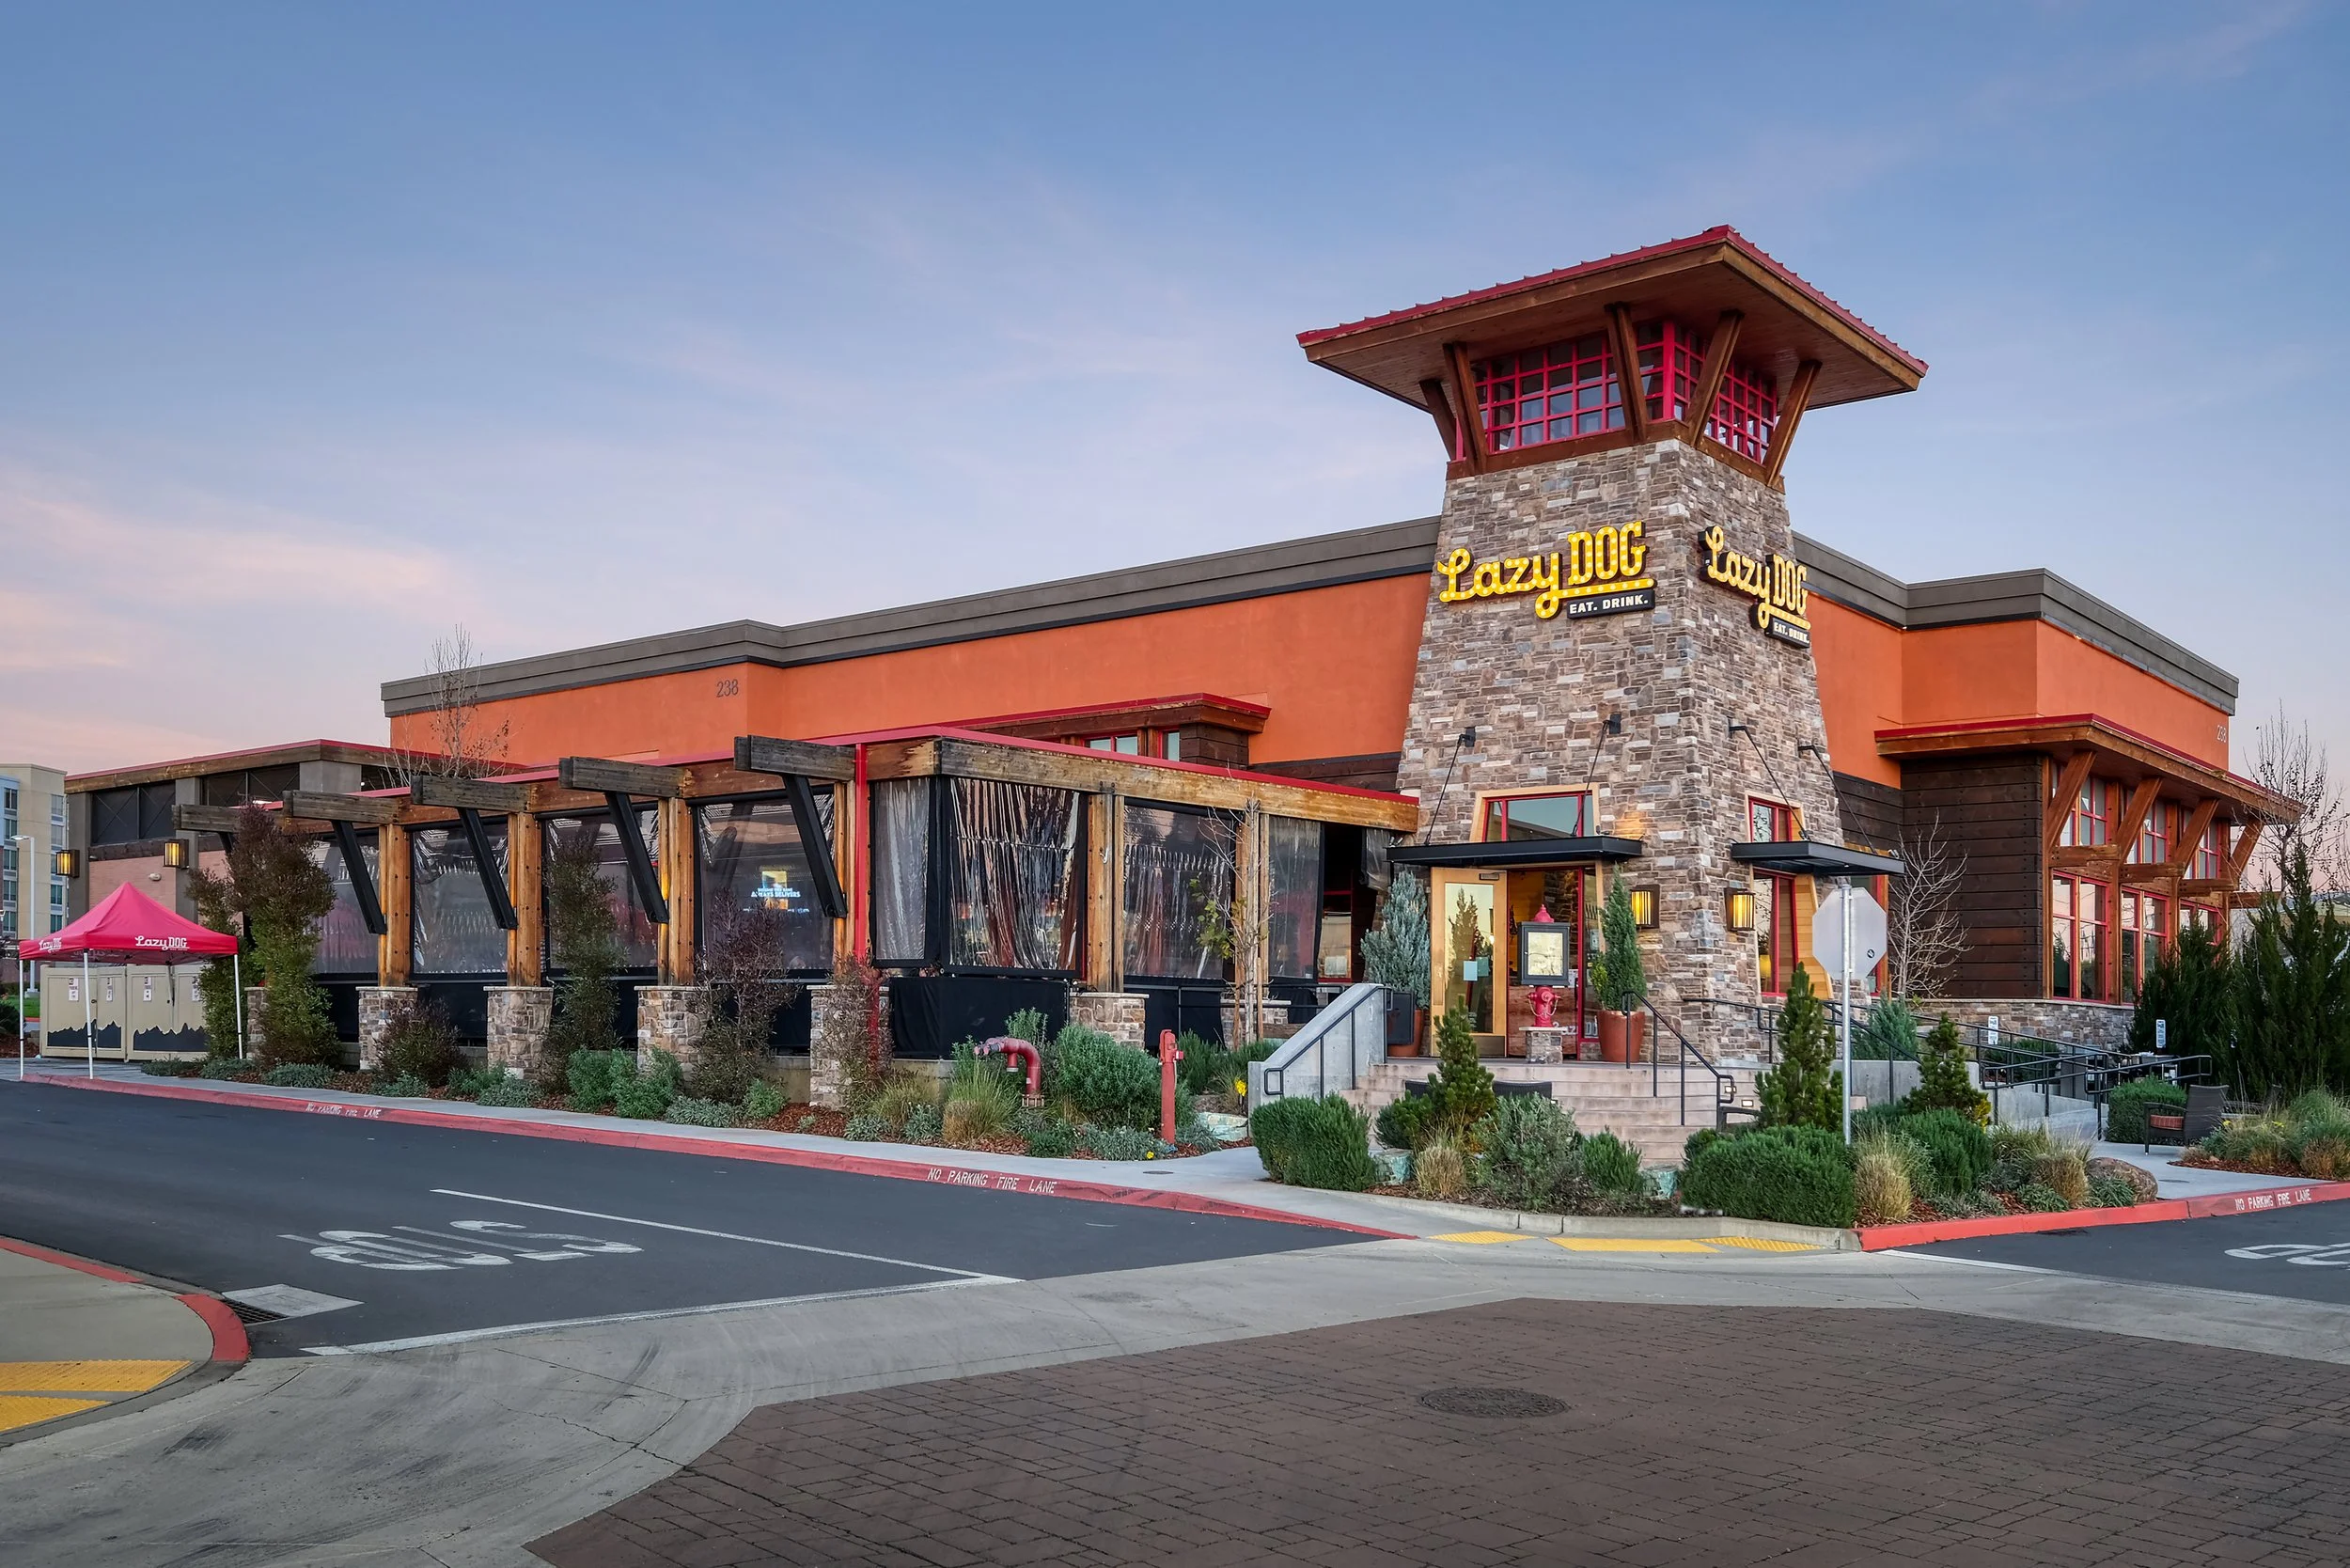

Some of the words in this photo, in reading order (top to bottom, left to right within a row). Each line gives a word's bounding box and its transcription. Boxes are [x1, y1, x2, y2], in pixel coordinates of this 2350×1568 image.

[1437, 548, 1560, 619] Lazy
[1567, 521, 1646, 585] DOG
[1706, 525, 1771, 629] Lazy
[1773, 554, 1809, 615] DOG
[1569, 604, 1597, 615] EAT.
[1602, 594, 1648, 610] DRINK.
[1774, 621, 1788, 635] EAT.
[716, 679, 739, 698] 238
[134, 935, 168, 950] Lazy
[168, 936, 187, 947] DOG
[364, 1109, 382, 1119] LANE
[927, 1168, 941, 1181] NO
[948, 1170, 988, 1186] PARKING
[996, 1176, 1020, 1190] FIRE
[1028, 1180, 1058, 1194] LANE
[2234, 1198, 2246, 1211] NO
[2248, 1195, 2274, 1210] PARKING
[2277, 1192, 2291, 1206] FIRE
[2295, 1188, 2311, 1202] LANE
